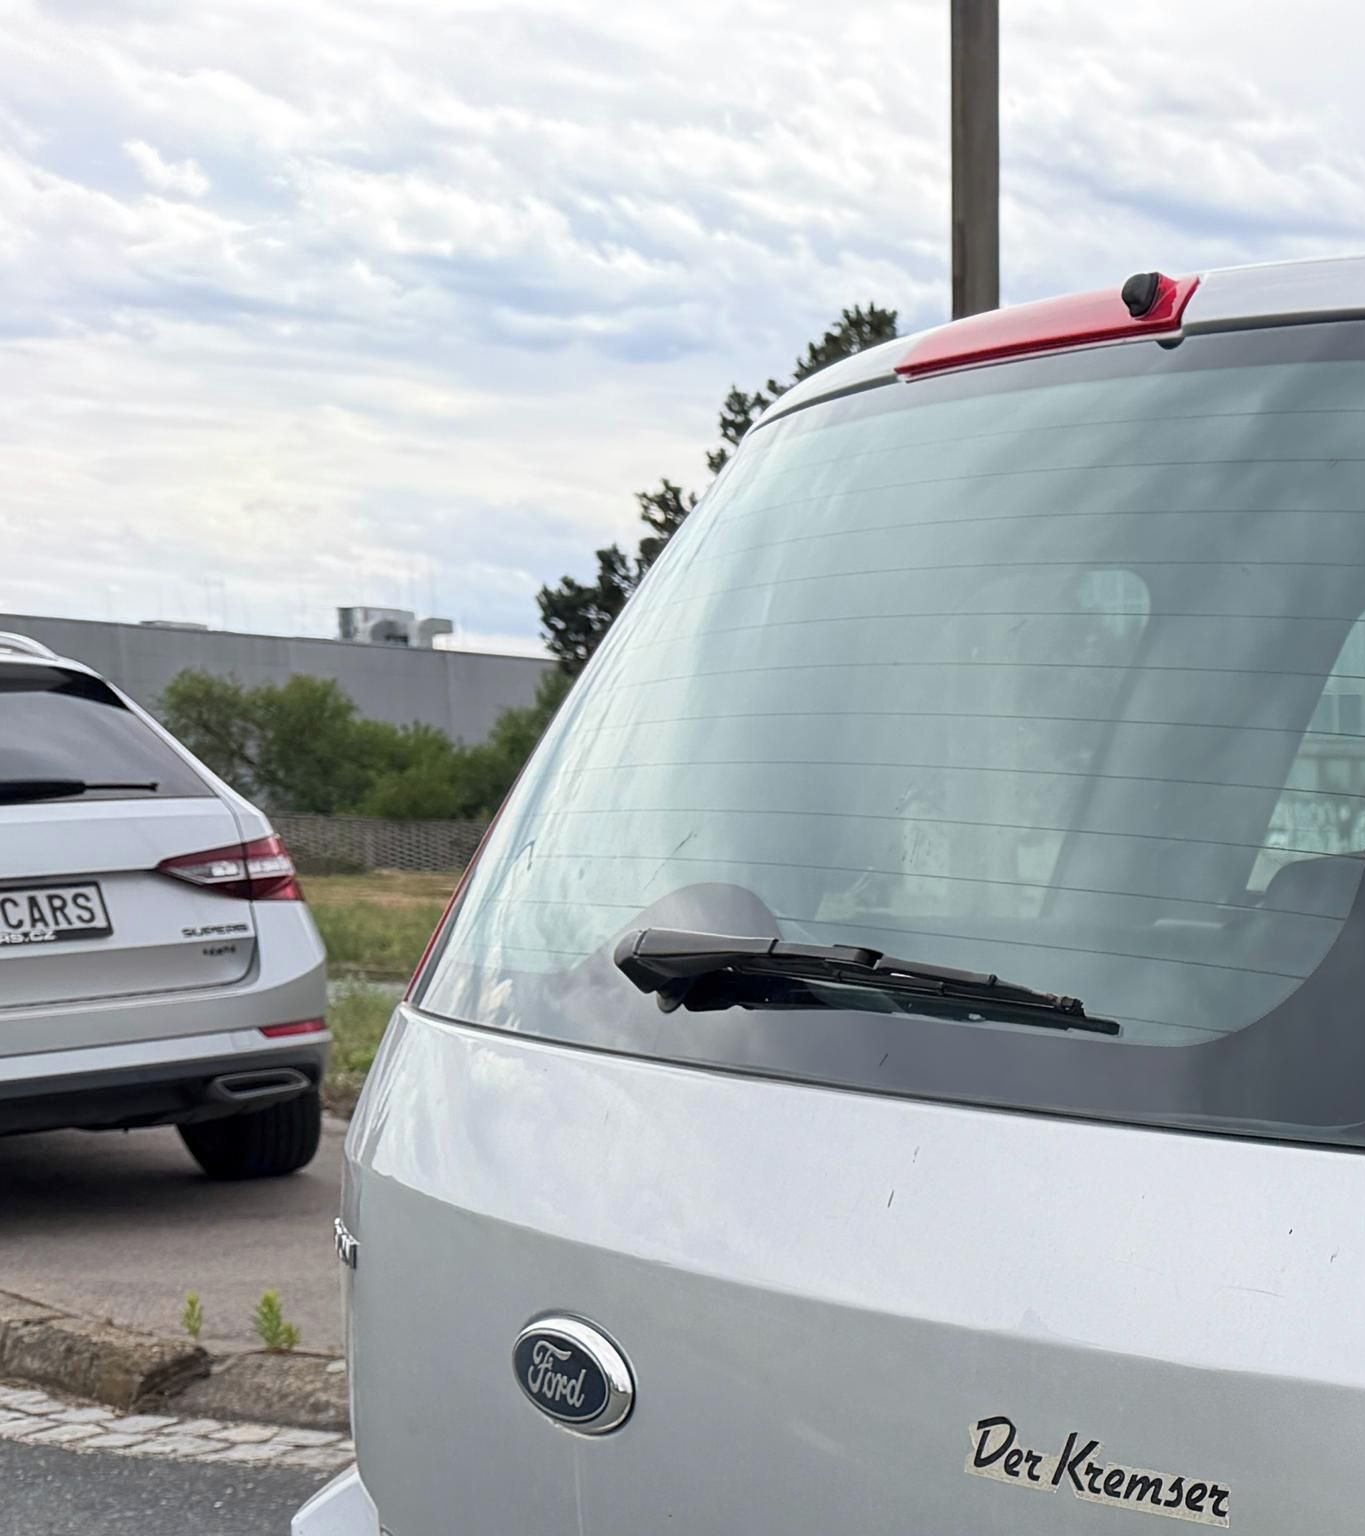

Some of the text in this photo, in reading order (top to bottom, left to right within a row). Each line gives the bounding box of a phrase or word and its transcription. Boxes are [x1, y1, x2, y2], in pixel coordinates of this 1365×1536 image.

[0, 892, 96, 930] CARS
[527, 1340, 587, 1409] Ford
[973, 1415, 1231, 1518] Der Kremser
